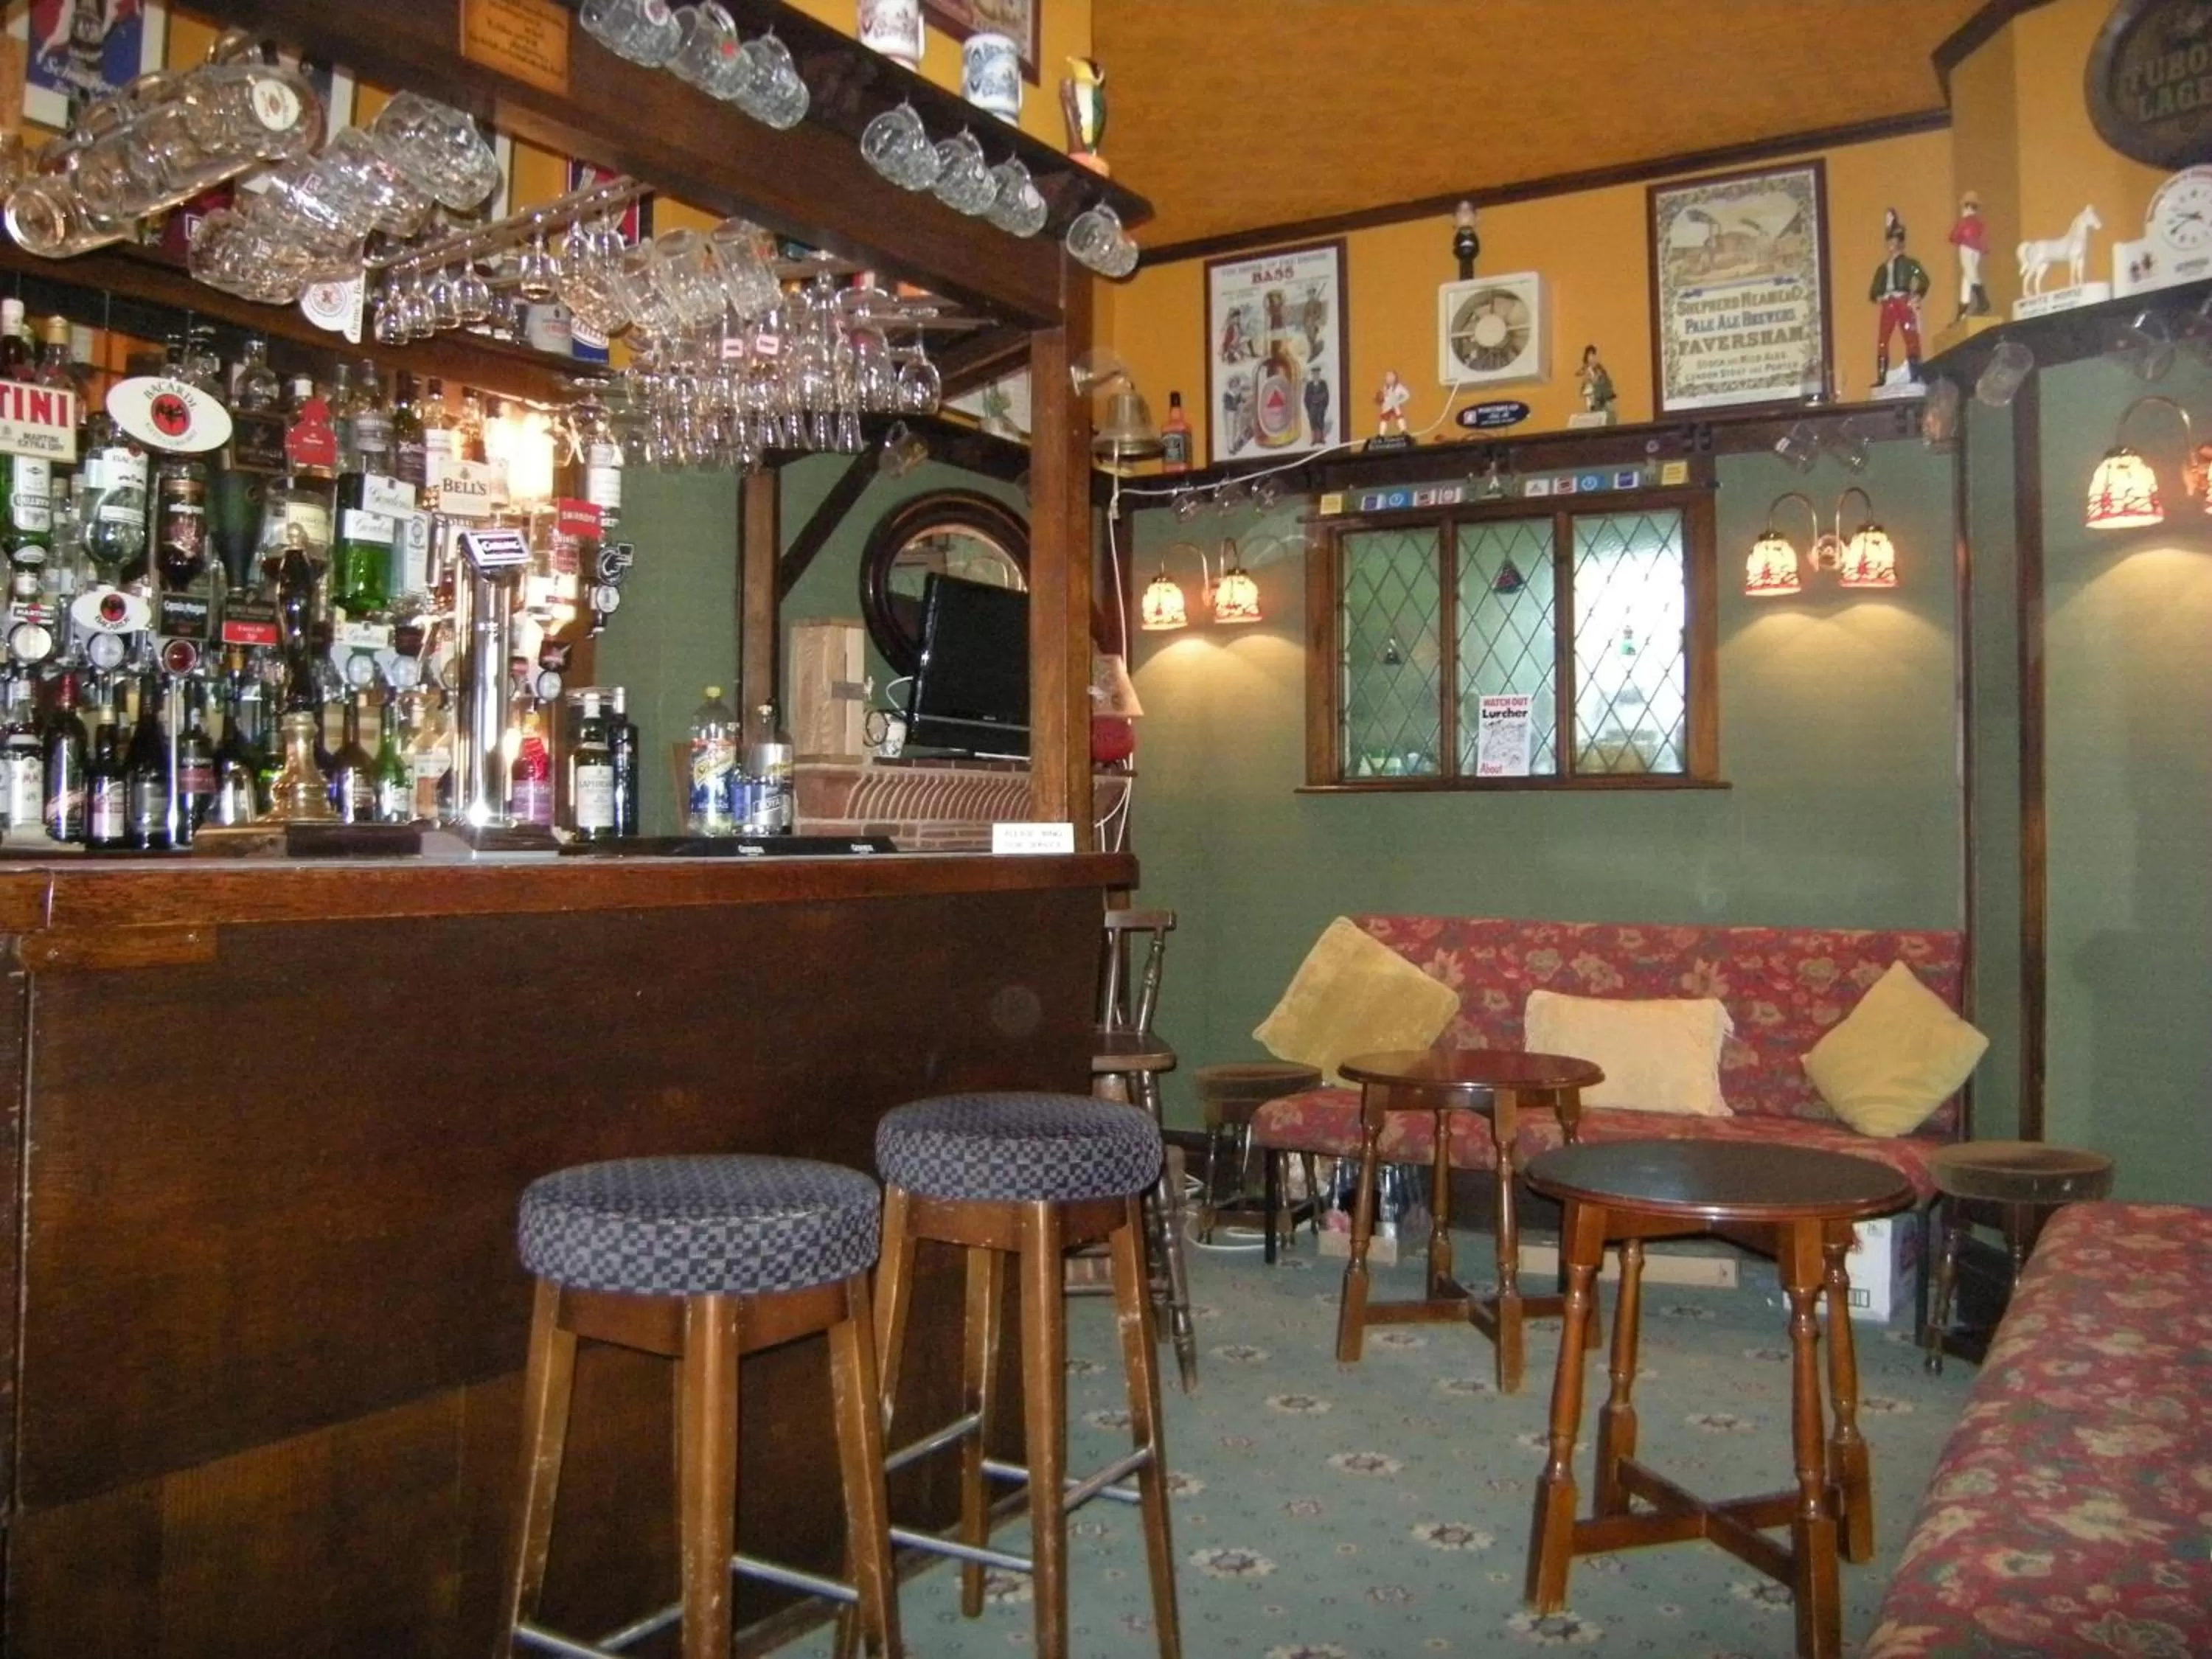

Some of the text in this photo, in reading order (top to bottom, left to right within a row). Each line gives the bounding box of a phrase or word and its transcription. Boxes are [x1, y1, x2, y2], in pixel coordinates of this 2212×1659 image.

[1251, 265, 1295, 285] BASS
[1685, 308, 1796, 335] PALE ALE BREWERS
[1678, 326, 1804, 355] FAVERSHAM
[144, 381, 198, 408] BACARDI
[443, 477, 487, 496] BELL'S
[1483, 697, 1528, 706] WATCH OUT
[1482, 708, 1528, 719] Lurcher
[1481, 762, 1503, 773] About
